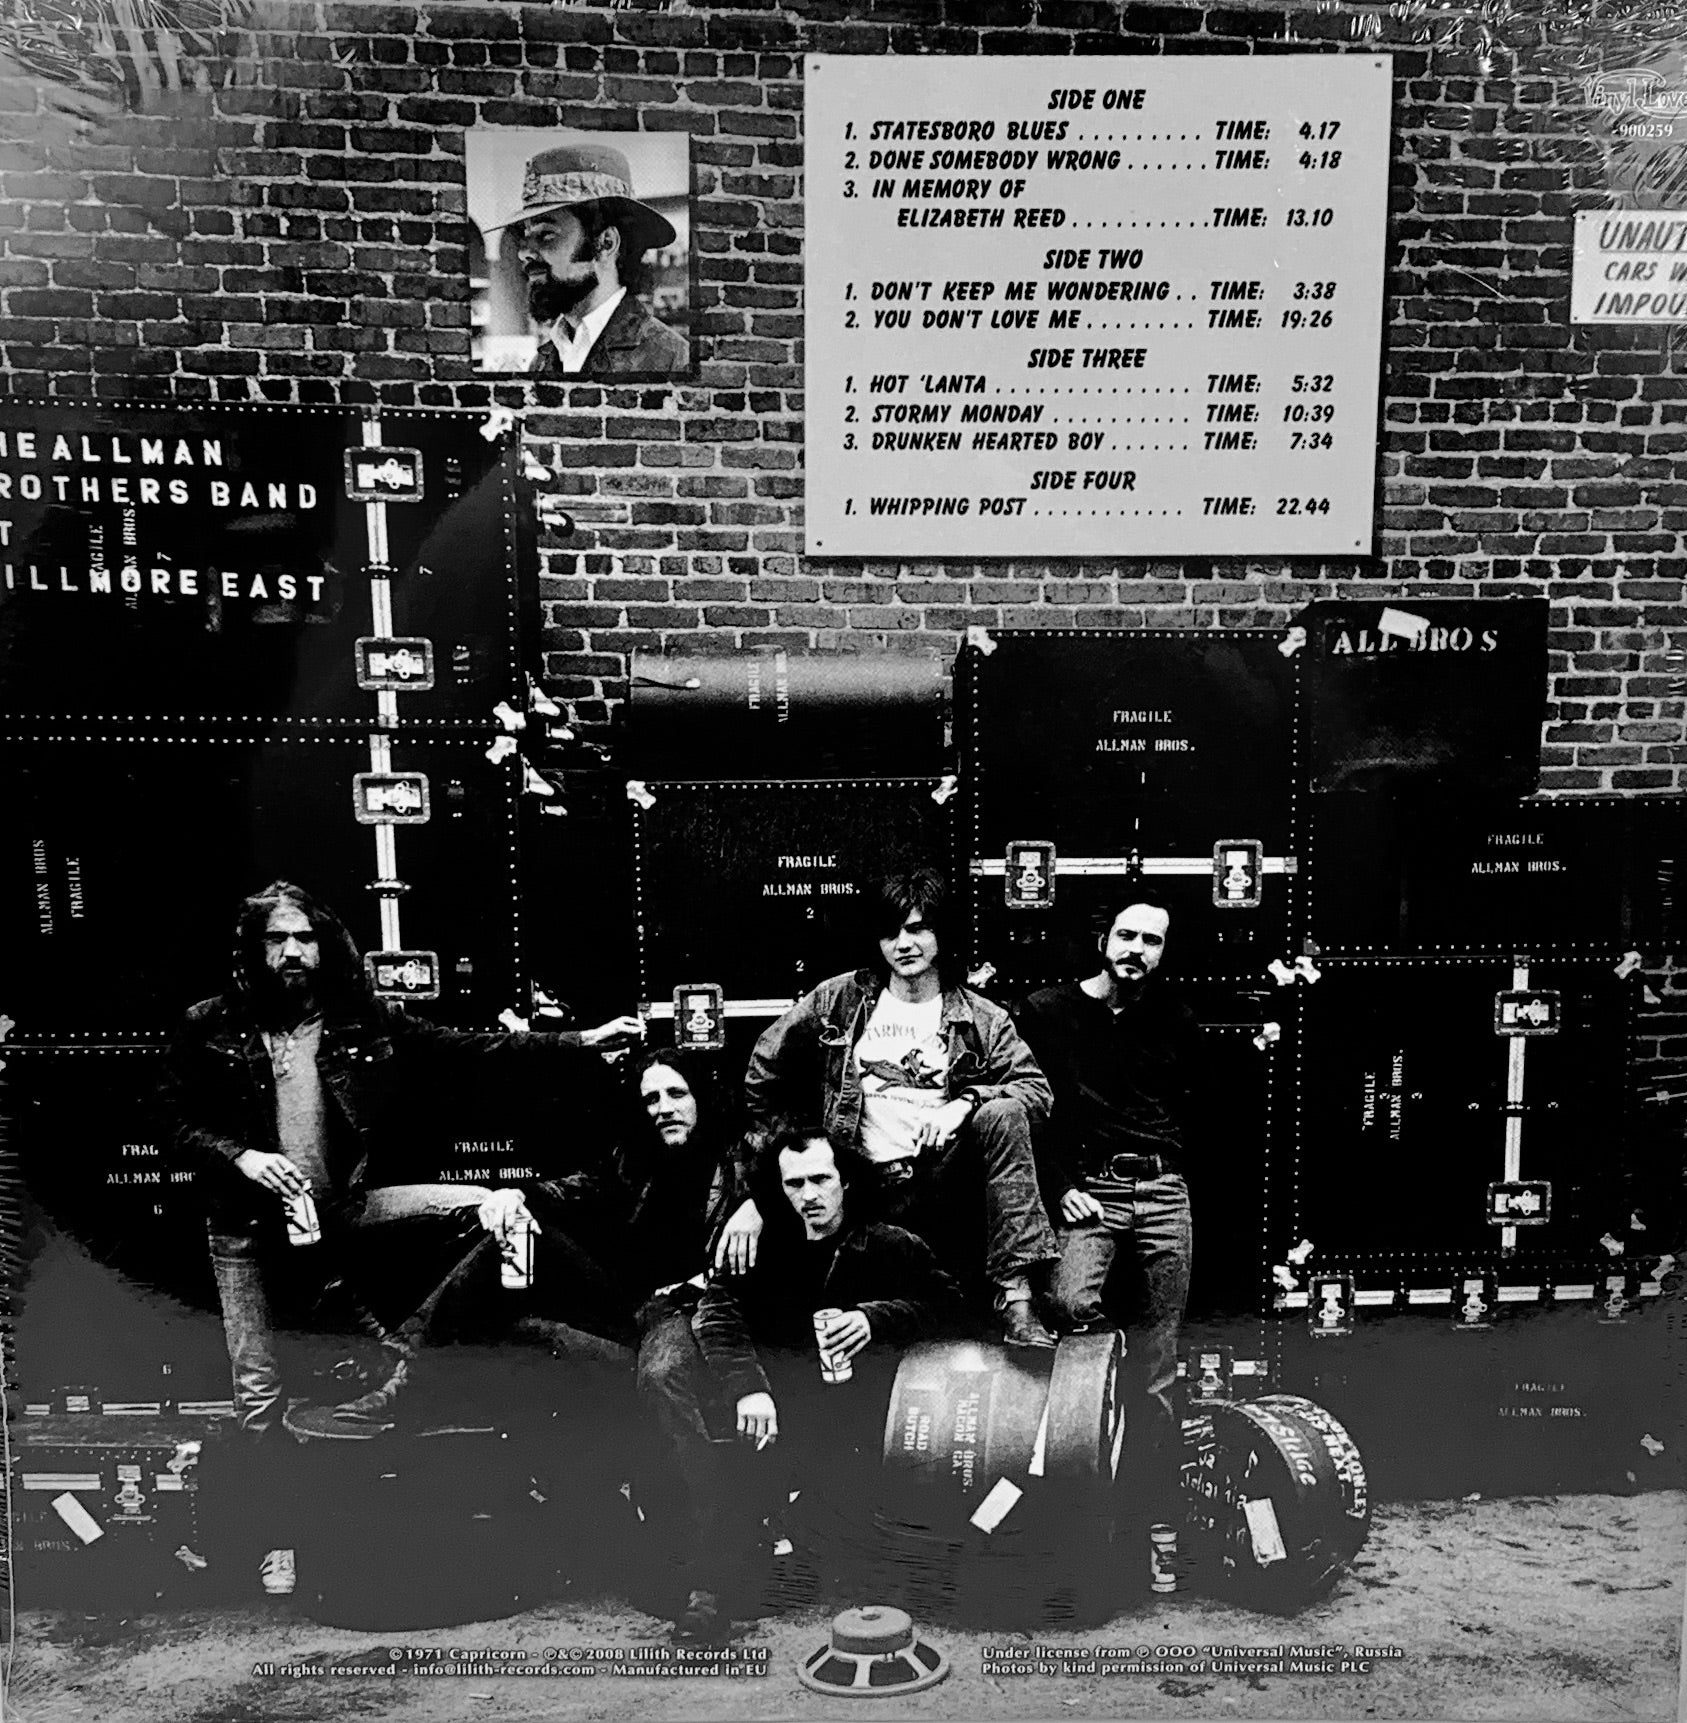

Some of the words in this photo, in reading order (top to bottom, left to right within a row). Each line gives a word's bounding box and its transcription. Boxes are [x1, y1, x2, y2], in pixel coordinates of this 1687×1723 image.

[1047, 88, 1097, 109] SIDE
[1102, 88, 1147, 109] ONE
[845, 120, 857, 141] 1.
[869, 120, 995, 141] STATESBORO
[1006, 120, 1070, 141] BLUES
[1215, 120, 1271, 141] TIME:
[1298, 120, 1341, 141] 4.17
[1619, 124, 1674, 137] 900259
[844, 149, 860, 171] 2.
[869, 149, 924, 171] DONE
[928, 149, 1039, 171] SOMEBODY
[1047, 149, 1121, 171] WRONG
[1215, 149, 1270, 171] TIME:
[1298, 149, 1343, 171] 4:18
[843, 178, 859, 199] 3.
[872, 178, 896, 199] IN
[902, 178, 992, 199] MEMORY
[999, 178, 1027, 199] OF
[897, 207, 1005, 229] ELIZABETH
[1013, 207, 1066, 229] REED
[1213, 207, 1268, 229] TIME:
[1286, 207, 1334, 229] 13.10
[1043, 248, 1092, 269] SIDE
[1098, 248, 1144, 269] TWO
[1604, 260, 1659, 281] CARS
[845, 281, 857, 301] 1.
[871, 281, 933, 301] DON'T
[942, 281, 995, 301] KEEP
[1004, 281, 1038, 301] ME
[1047, 281, 1170, 301] WONDERING
[1210, 281, 1265, 301] TIME:
[1293, 281, 1337, 301] 3:38
[844, 309, 860, 329] 2.
[874, 309, 912, 329] YOU
[922, 309, 983, 329] DON'T
[990, 309, 1040, 329] LOVE
[1048, 309, 1082, 329] ME
[1208, 309, 1262, 329] TIME:
[1281, 309, 1333, 329] 19:26
[1027, 348, 1075, 369] SIDE
[1082, 348, 1148, 369] THREE
[845, 374, 857, 393] 1.
[870, 374, 910, 393] HOT
[920, 374, 986, 393] 'LANTA
[1207, 374, 1261, 393] TIME:
[1291, 374, 1334, 393] 5:32
[844, 403, 859, 423] 2.
[872, 403, 952, 423] STORMY
[960, 403, 1045, 423] MONDAY
[1206, 403, 1260, 423] TIME:
[1283, 403, 1335, 423] 10:39
[52, 434, 223, 466] ALLMAN
[843, 431, 858, 451] 3.
[871, 431, 963, 451] DRUNKEN
[972, 431, 1058, 451] HEARTED
[1068, 431, 1105, 451] BOY
[1204, 431, 1258, 451] TIME:
[1290, 431, 1333, 451] 7:34
[1030, 470, 1077, 491] SIDE
[1083, 470, 1136, 491] FOUR
[211, 480, 317, 509] BAND
[845, 496, 857, 515] 1.
[870, 496, 970, 515] WHIPPING
[978, 496, 1028, 515] POST
[1203, 496, 1256, 515] TIME:
[1276, 496, 1330, 515] 22.44
[221, 571, 325, 601] EAST
[1113, 709, 1173, 723] FRAGILE
[1095, 739, 1146, 752] ALLMAN
[1154, 739, 1196, 752] BROS.
[1487, 833, 1545, 845] FRAGILE
[778, 855, 837, 868] FRAGILE
[1471, 861, 1520, 874] ALLMAN
[1527, 860, 1568, 872] BROS.
[66, 857, 84, 918] FRAGILE
[762, 883, 812, 896] ALLMAN
[820, 883, 861, 895] BROS.
[36, 884, 53, 934] ALLMAN
[806, 907, 815, 919] 2
[796, 960, 805, 972] 2
[1362, 1072, 1376, 1126] FRAGILE
[1390, 1095, 1402, 1140] ALLMAN
[454, 1140, 514, 1153] FRAGILE
[107, 1172, 161, 1185] ALLMAN
[439, 1168, 491, 1181] ALLMAN
[499, 1167, 541, 1179] BROS.
[449, 1648, 526, 1662] Capricorn
[630, 1647, 670, 1660] Lilith
[676, 1648, 737, 1660] Records
[743, 1648, 768, 1660] Ltd
[983, 1646, 1030, 1659] Under
[1036, 1646, 1089, 1659] license
[1095, 1645, 1130, 1658] from
[1355, 1646, 1402, 1657] Russia
[252, 1663, 274, 1676] All
[280, 1663, 324, 1678] rights
[330, 1663, 396, 1675] reserved
[414, 1663, 595, 1676] info@lilith-records.com
[612, 1663, 719, 1676] Manufactured
[725, 1664, 740, 1676] in
[745, 1664, 767, 1676] EU
[982, 1662, 1033, 1674] Photos
[1039, 1662, 1057, 1676] by
[1063, 1661, 1096, 1674] kind
[1102, 1661, 1184, 1675] permission
[1190, 1661, 1205, 1673] of
[1211, 1661, 1284, 1673] Universal
[1289, 1661, 1335, 1673] Music
[1341, 1661, 1370, 1673] PLC
